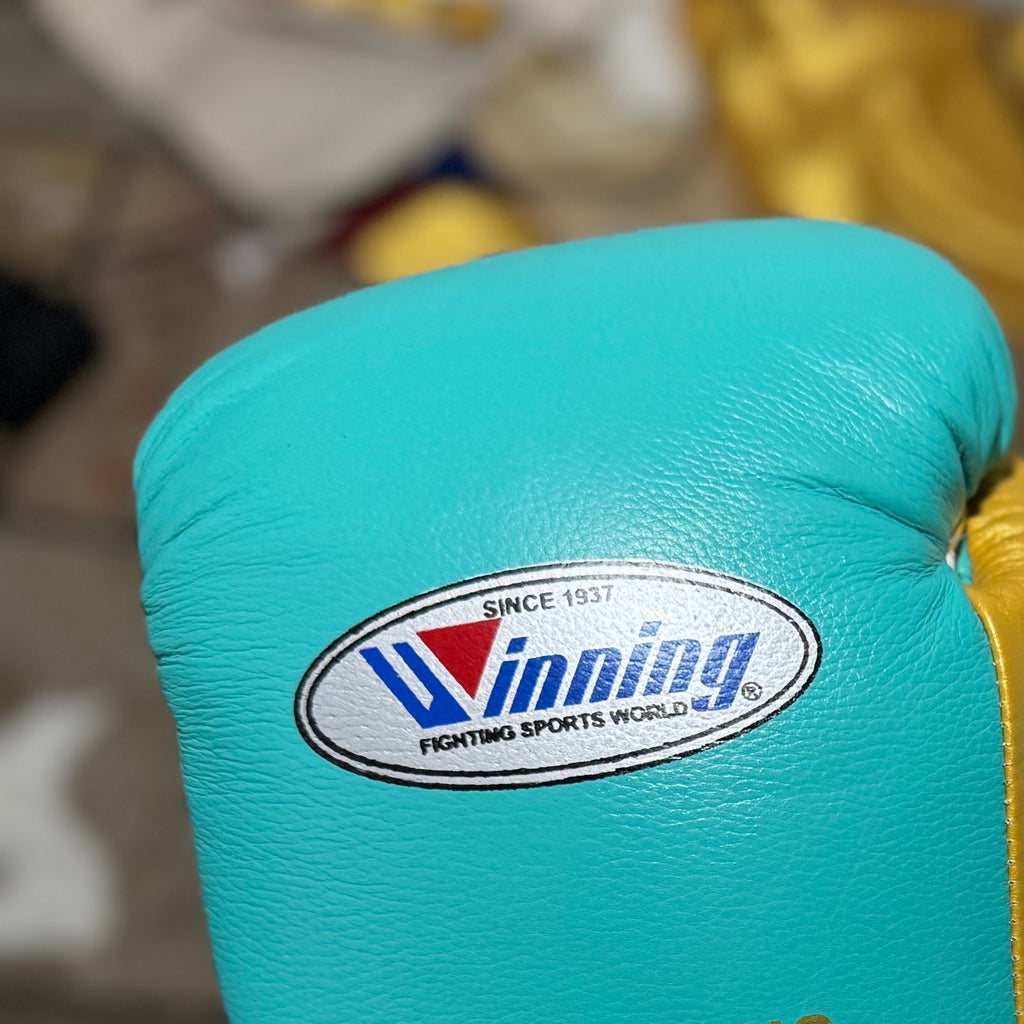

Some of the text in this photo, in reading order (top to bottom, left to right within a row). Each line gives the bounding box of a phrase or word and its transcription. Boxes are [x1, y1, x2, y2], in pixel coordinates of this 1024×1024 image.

[482, 584, 615, 619] SINCE 1937
[359, 618, 761, 730] Winning
[419, 700, 689, 755] FIGHTING SPORTS WORLD
